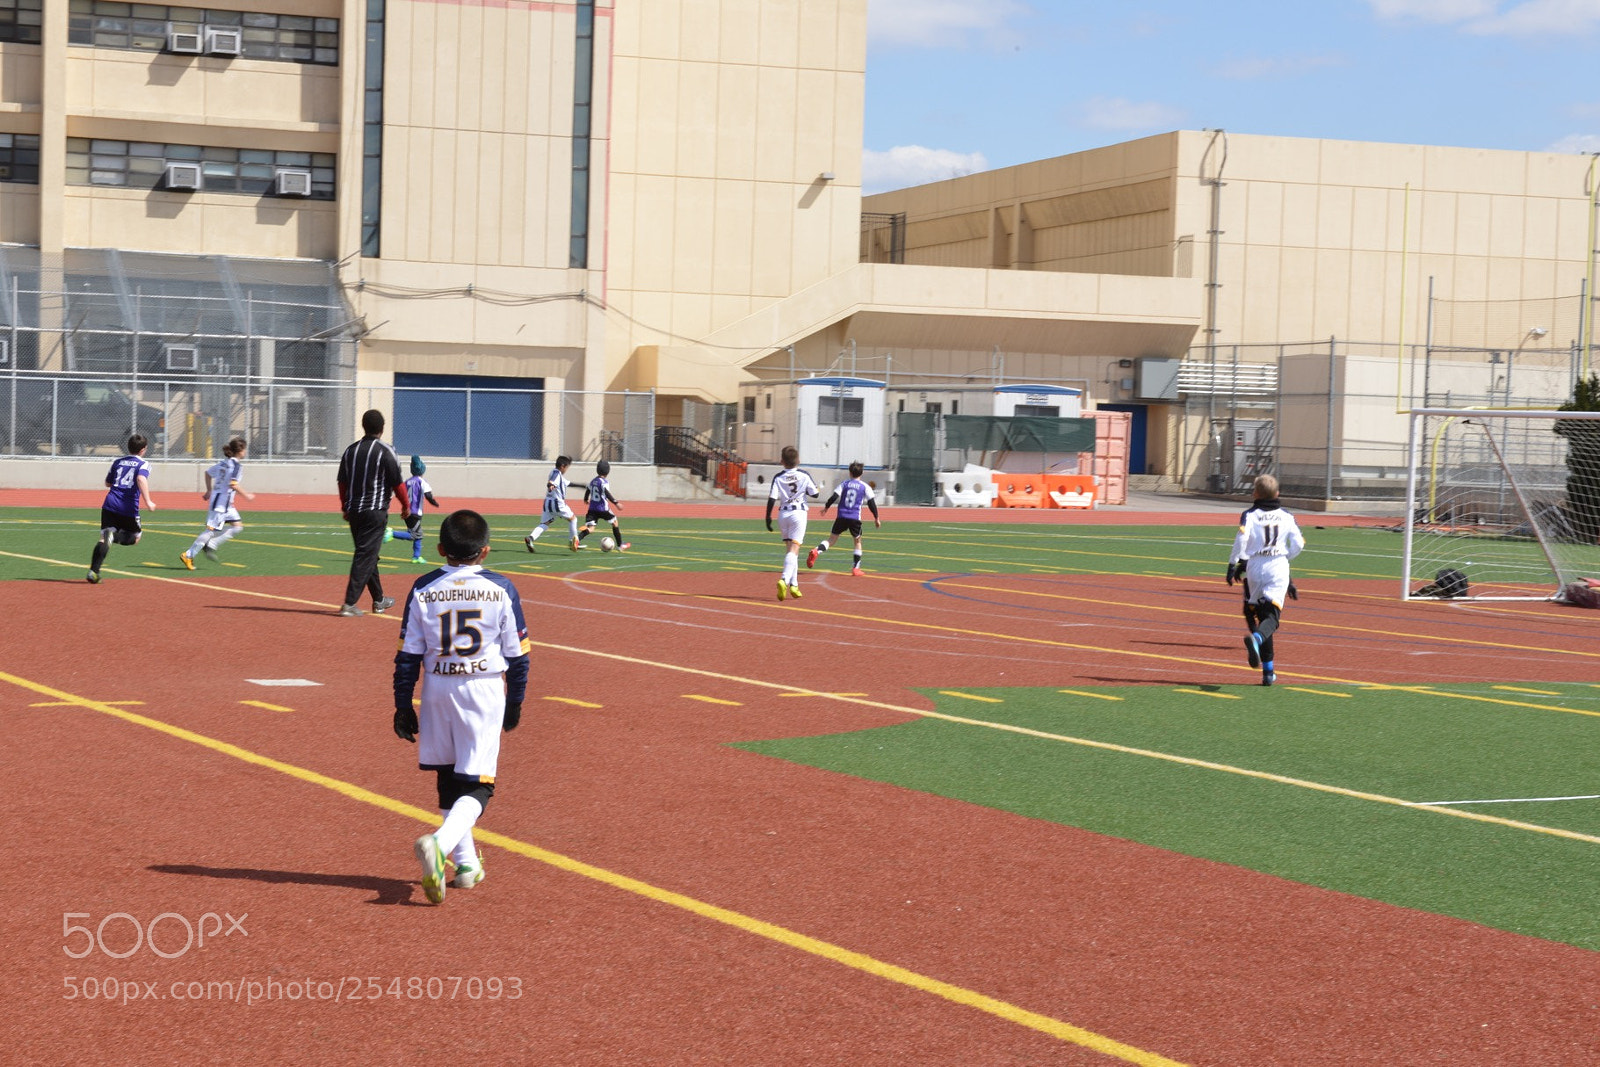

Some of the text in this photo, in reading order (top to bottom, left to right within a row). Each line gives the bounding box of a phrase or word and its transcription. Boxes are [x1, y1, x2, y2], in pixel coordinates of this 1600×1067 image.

[114, 466, 135, 488] 14
[845, 489, 857, 508] 8
[1263, 524, 1279, 547] 11
[418, 589, 503, 603] CHOQUEHUAMANI
[437, 608, 483, 657] 15
[432, 659, 487, 675] ALBA FC
